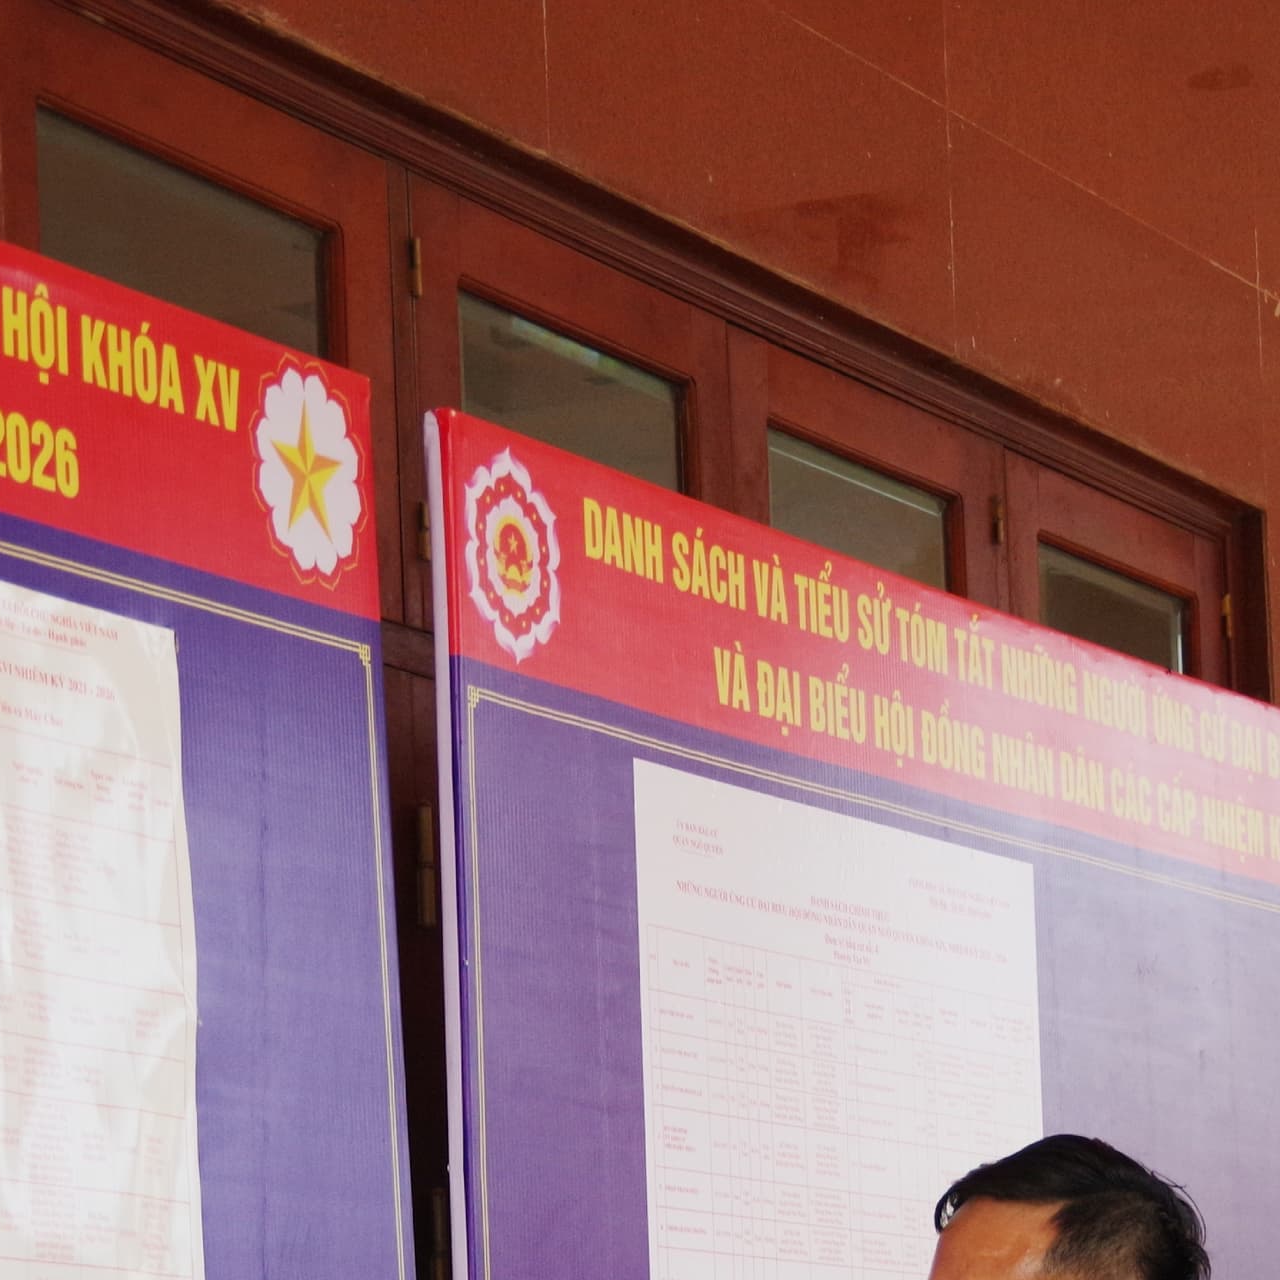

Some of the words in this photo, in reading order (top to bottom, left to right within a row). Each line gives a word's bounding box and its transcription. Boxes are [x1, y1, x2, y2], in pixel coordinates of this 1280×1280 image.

[2, 281, 69, 385] HỘI
[80, 312, 184, 415] KHÓA
[194, 353, 240, 433] XV
[583, 497, 665, 583] DANH
[672, 528, 746, 610] SÁCH
[753, 552, 789, 624] VÀ
[794, 560, 849, 643] TIỂU
[857, 582, 892, 656] SỬ
[896, 603, 949, 676] TÓM
[954, 615, 995, 690] TẮT
[1001, 638, 1078, 714] NHỮNG
[1083, 670, 1147, 737] NGƯỜI
[1152, 688, 1194, 748] ỨNG
[714, 642, 751, 712] VÀ
[757, 661, 802, 736] ĐẠI
[809, 663, 866, 744] BIỂU
[874, 690, 915, 767] HỘI
[922, 700, 986, 779] ĐỒNG
[993, 727, 1055, 798] NHÂN
[1060, 751, 1105, 812] DÂN
[1111, 767, 1153, 826] CÁC
[1158, 773, 1198, 837] CẤP
[1203, 796, 1265, 862] NHIỆM
